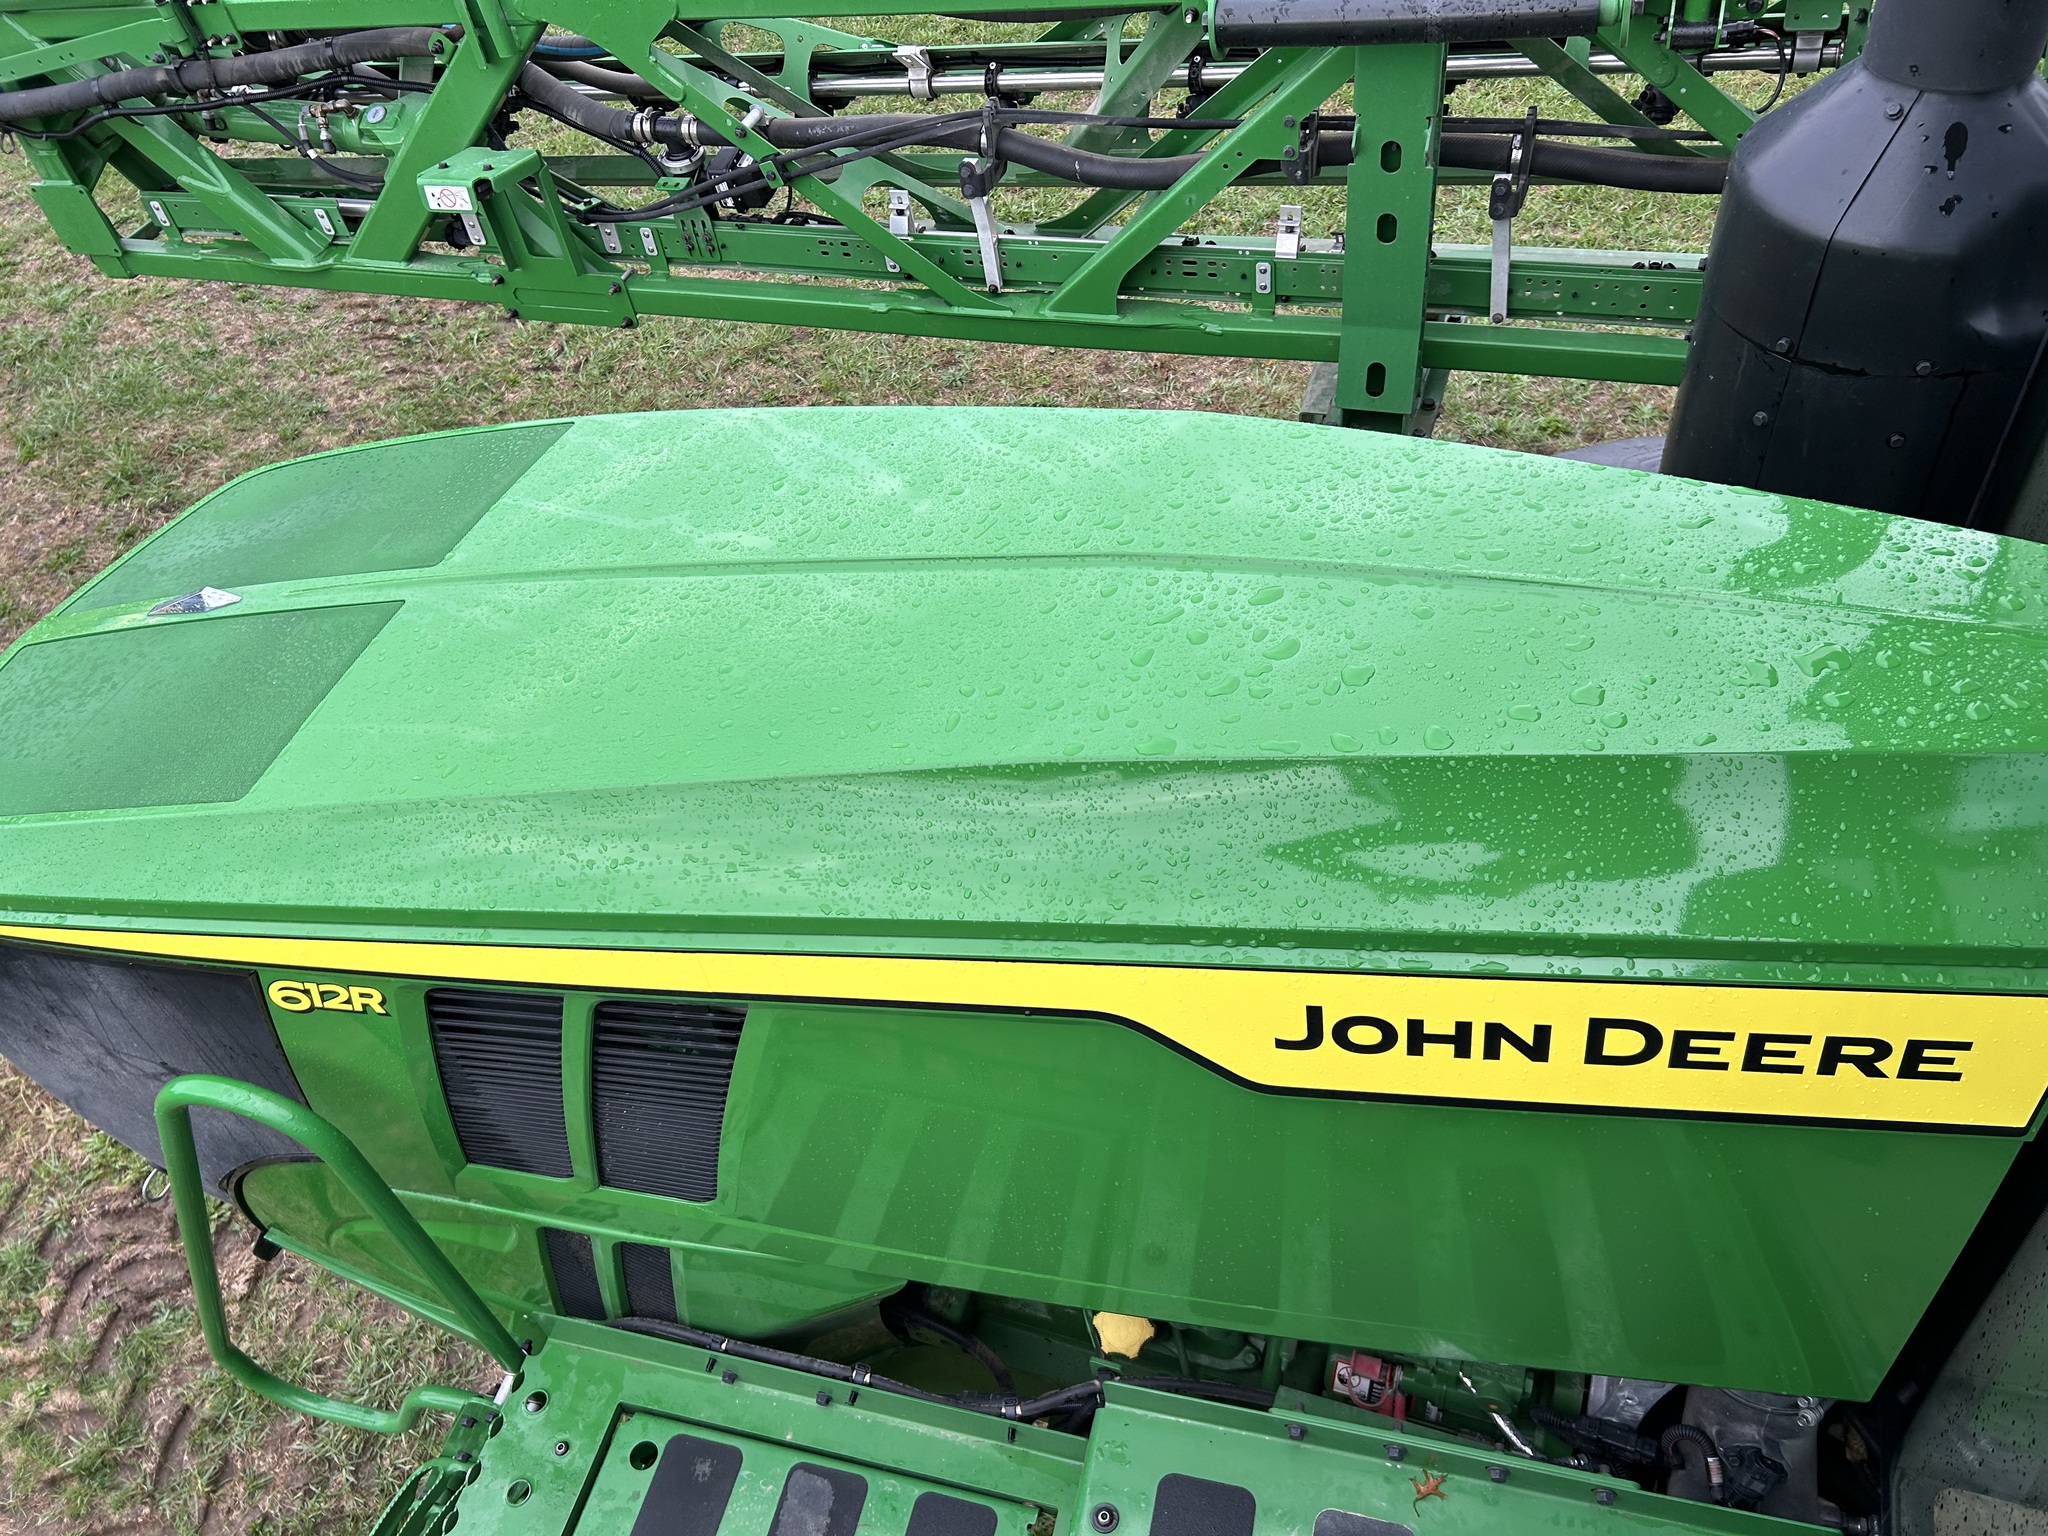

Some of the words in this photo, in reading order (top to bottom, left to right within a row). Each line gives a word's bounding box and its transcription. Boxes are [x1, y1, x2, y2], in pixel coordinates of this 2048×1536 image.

[267, 979, 388, 1014] 612R
[1274, 1005, 1552, 1063] JOHN
[1583, 1017, 1974, 1082] DEERE
